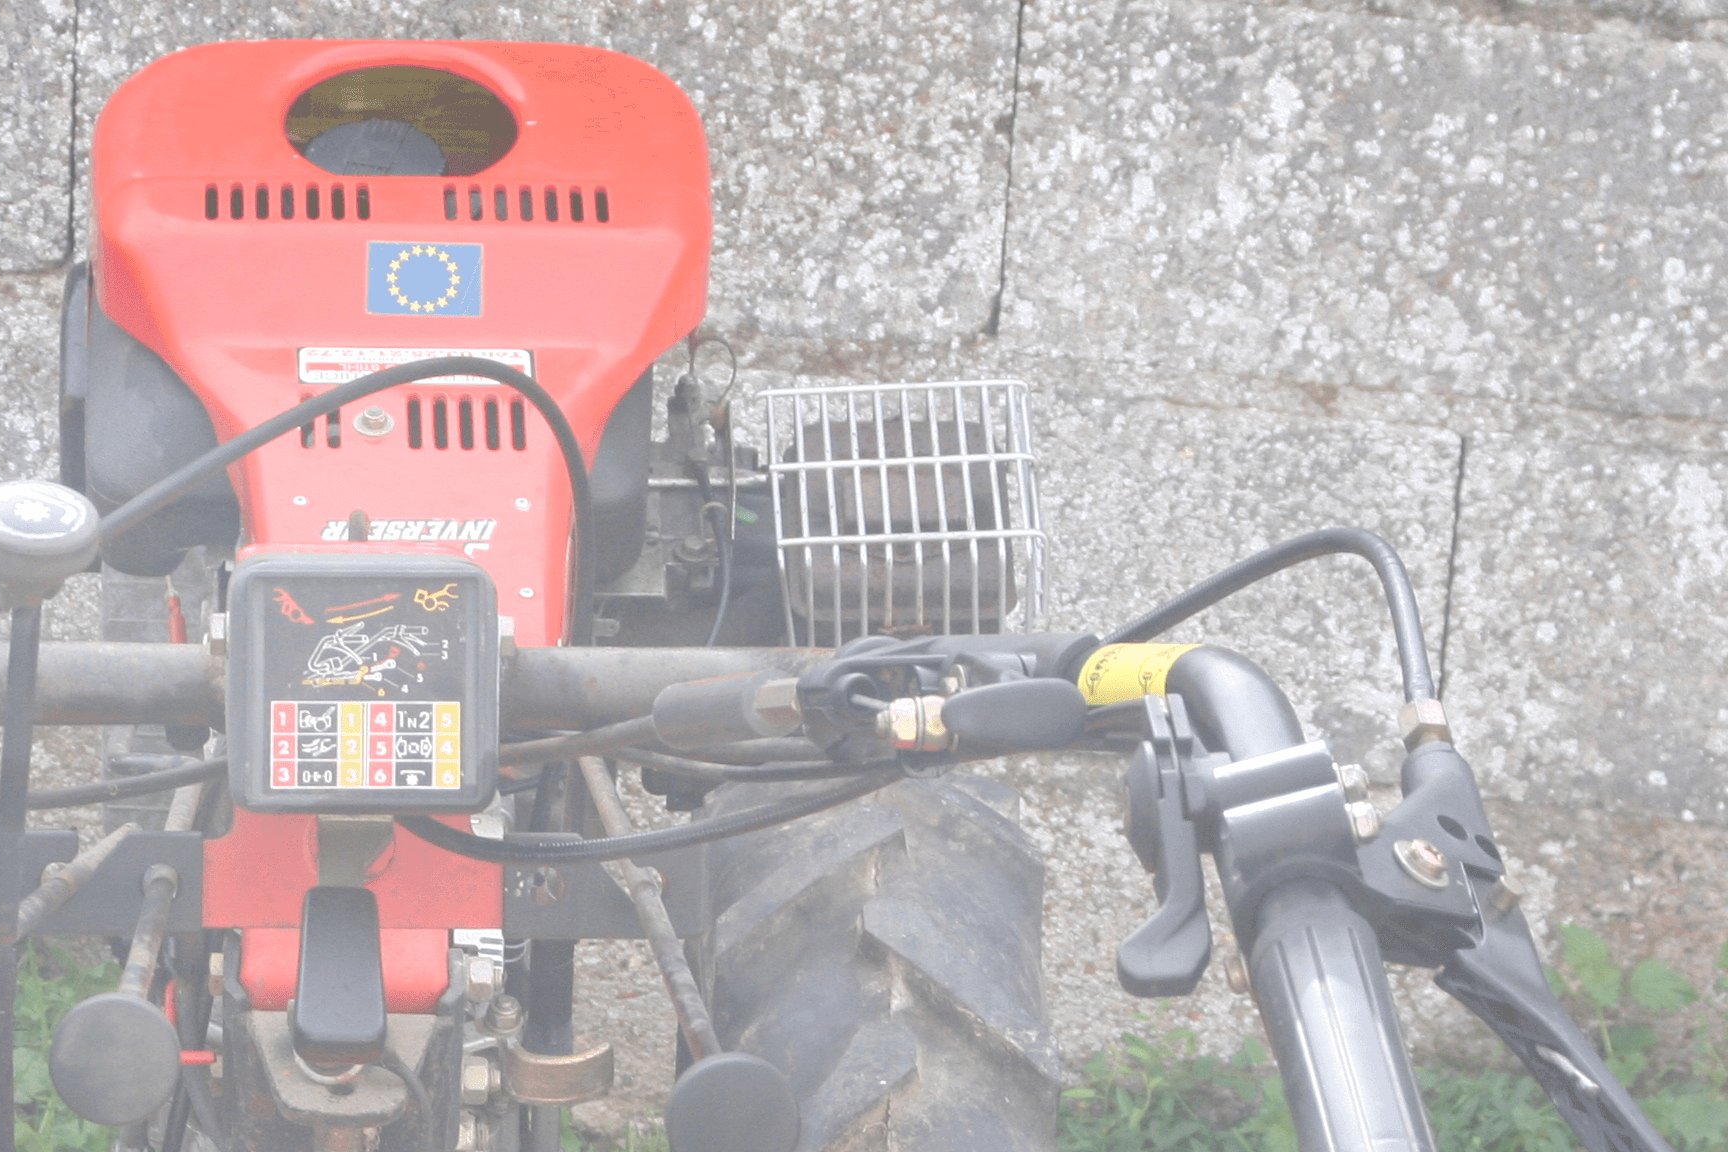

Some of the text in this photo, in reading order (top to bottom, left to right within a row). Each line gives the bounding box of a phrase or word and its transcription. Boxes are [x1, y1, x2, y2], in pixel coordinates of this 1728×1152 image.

[278, 711, 287, 727] 1
[347, 712, 355, 728] 1
[374, 711, 388, 727] 4
[440, 712, 452, 728] 5
[277, 740, 290, 755] 2
[346, 739, 358, 755] 2
[375, 741, 388, 756] 5
[440, 740, 453, 755] 4
[277, 767, 290, 782] 3
[346, 768, 358, 783] 3
[374, 768, 387, 783] 6
[442, 770, 454, 784] 6
